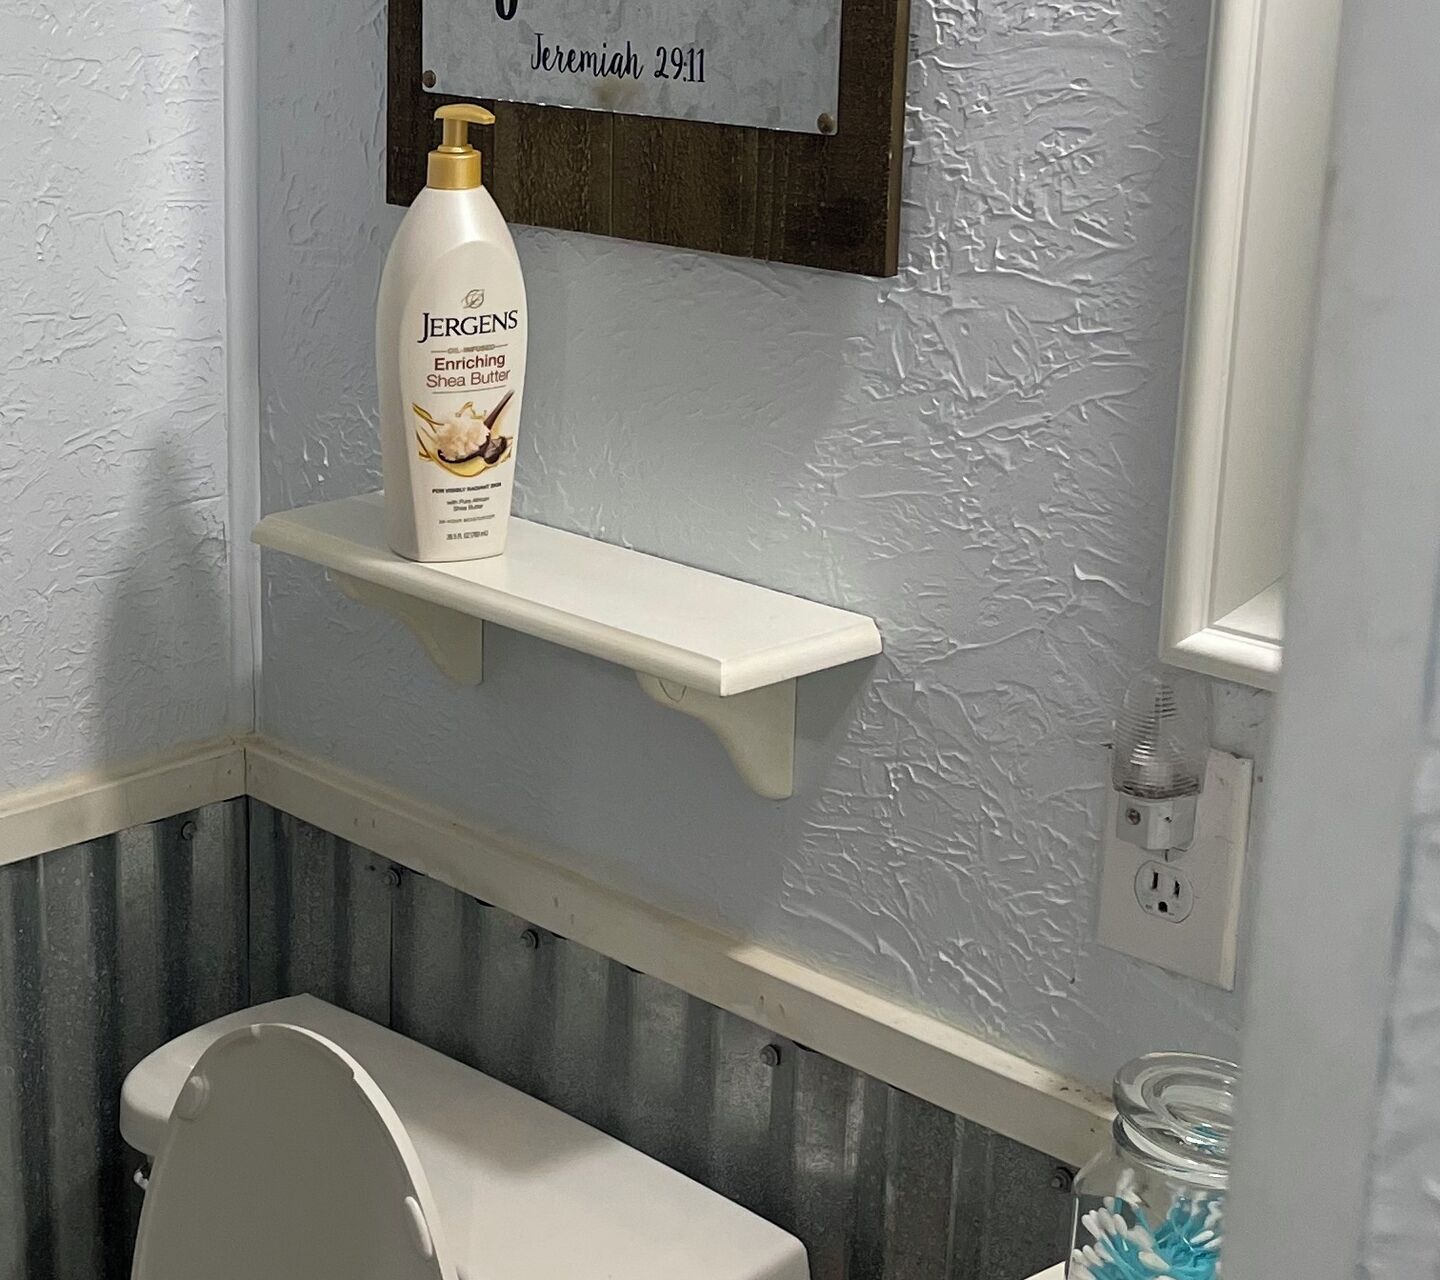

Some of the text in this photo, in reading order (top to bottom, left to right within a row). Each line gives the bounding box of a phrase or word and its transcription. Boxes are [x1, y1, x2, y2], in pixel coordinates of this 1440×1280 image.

[530, 32, 706, 83] Jeremiah 29:11
[417, 309, 518, 343] JERGENS
[434, 354, 506, 371] Enriching
[426, 369, 511, 388] Shea Butter
